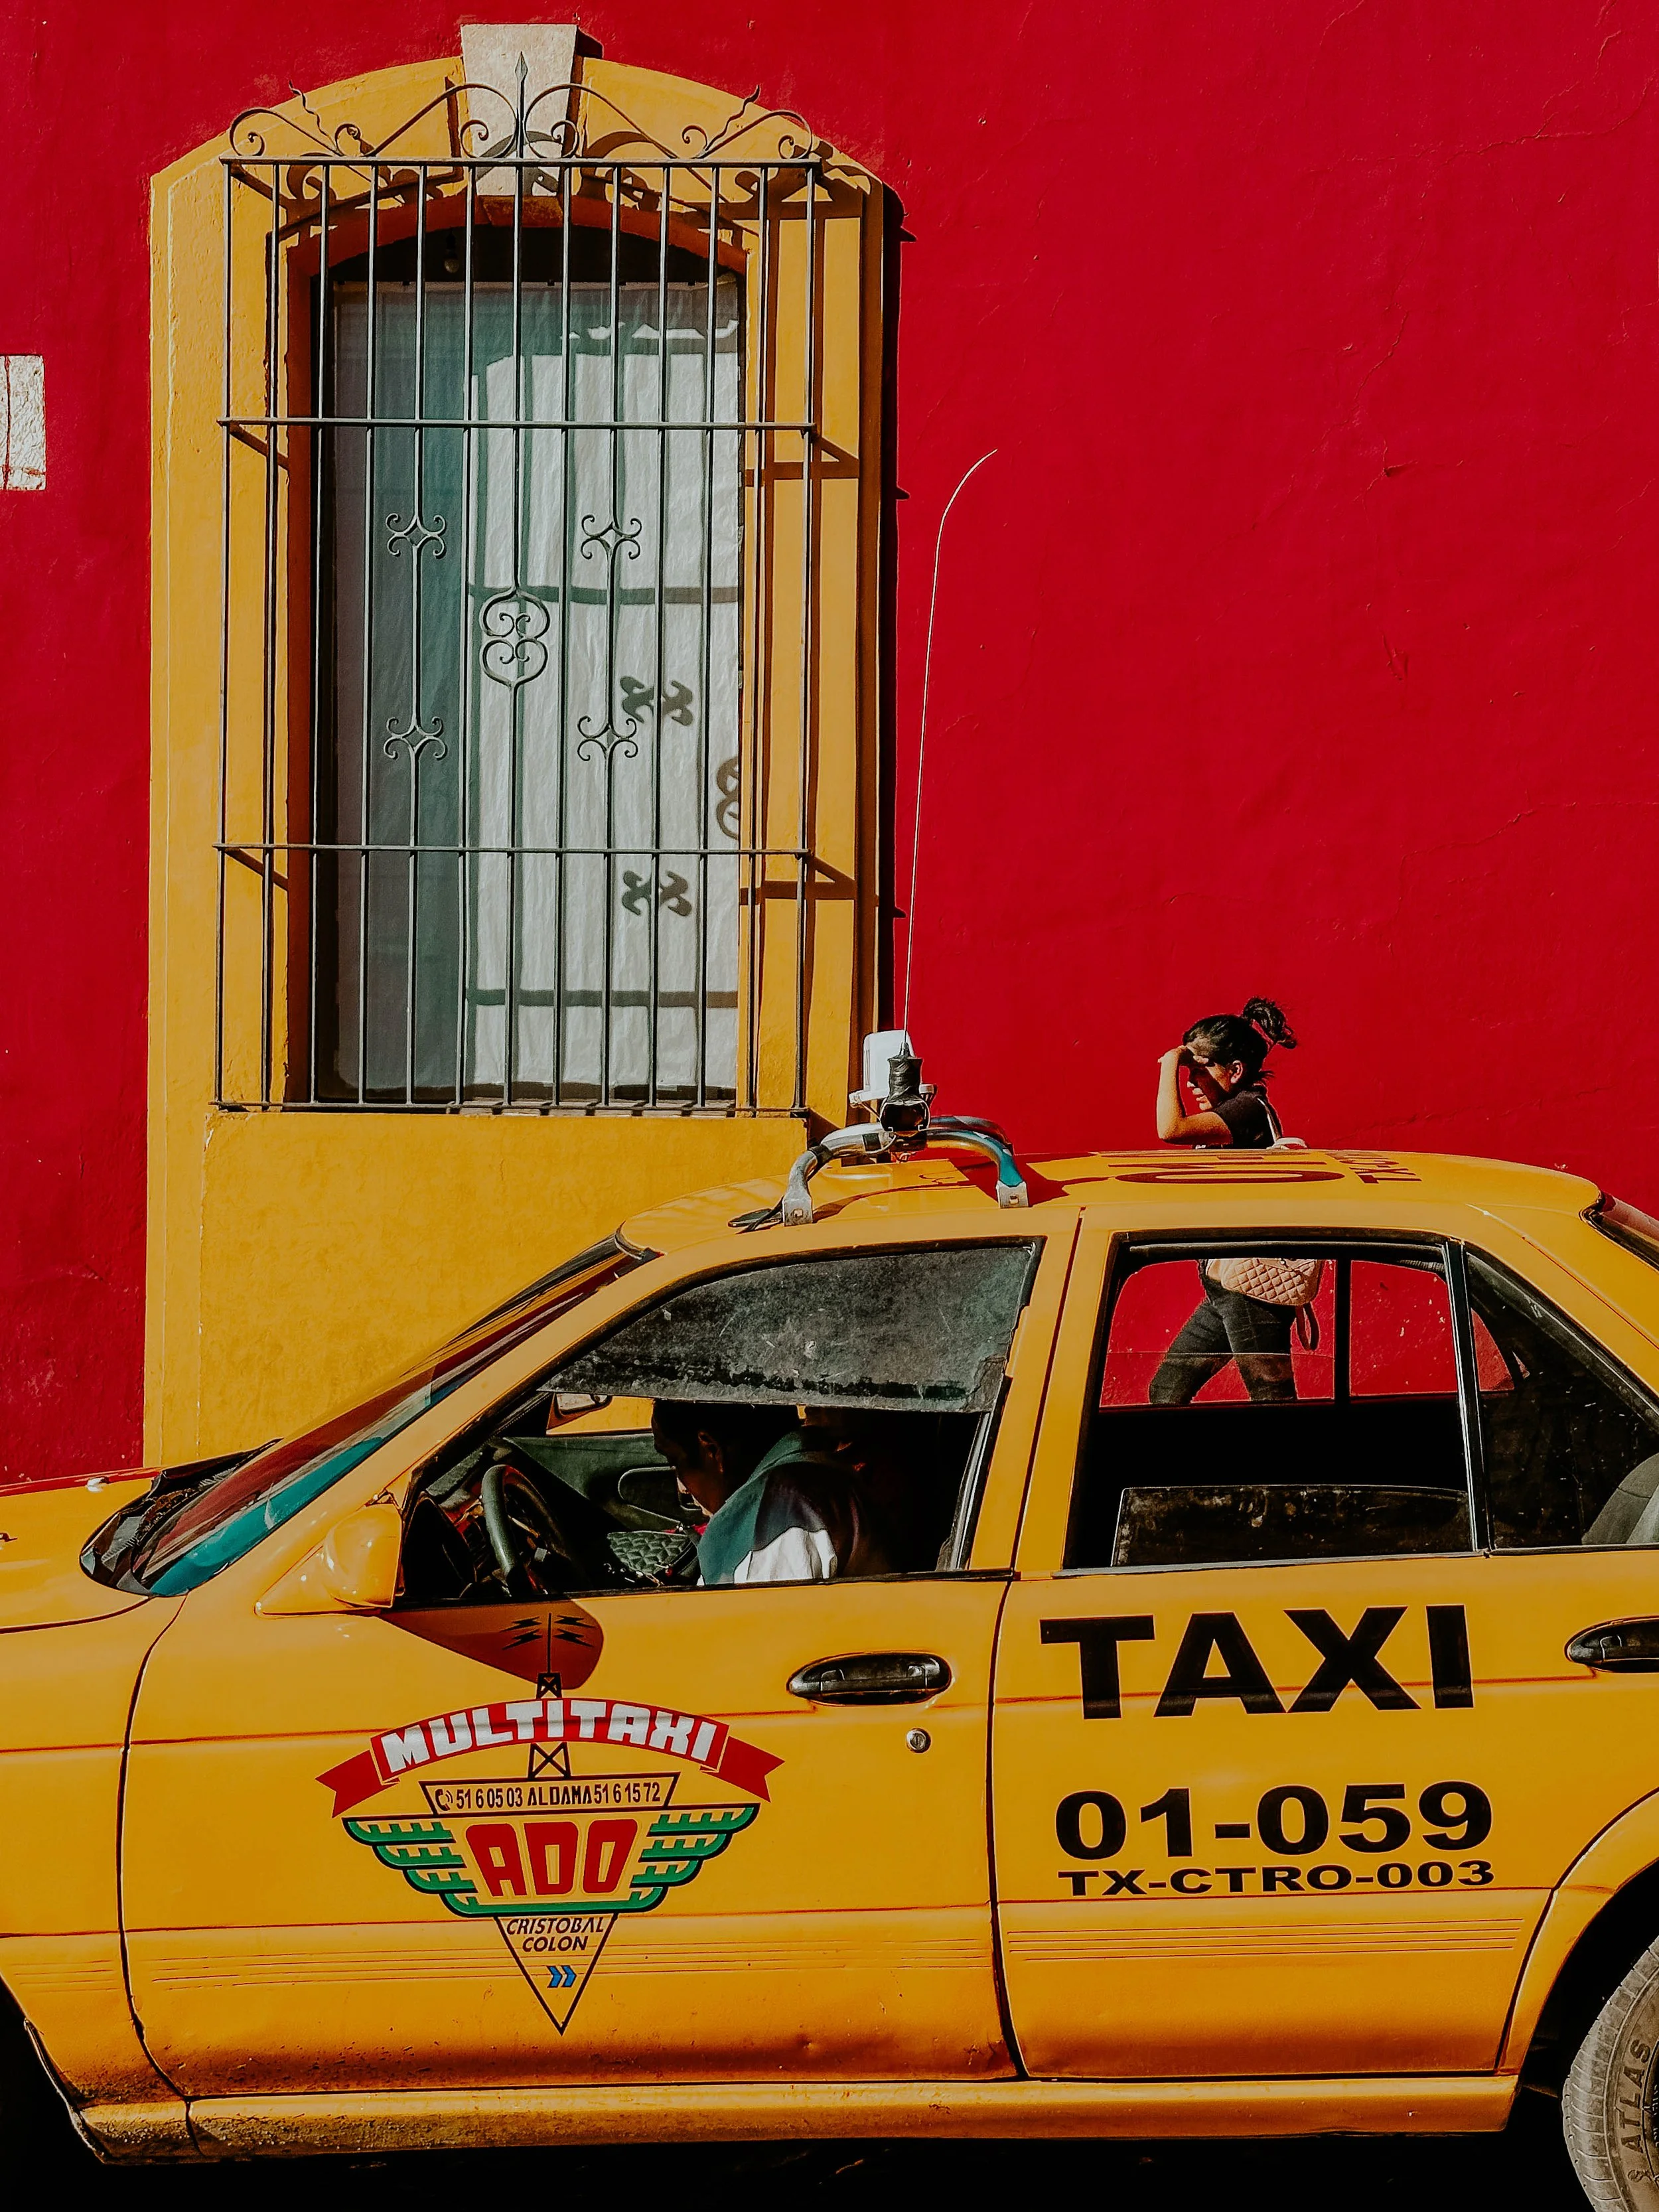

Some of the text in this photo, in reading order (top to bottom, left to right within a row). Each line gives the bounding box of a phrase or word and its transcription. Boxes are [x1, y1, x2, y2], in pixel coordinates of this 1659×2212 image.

[1040, 1604, 1475, 1719] TAXI
[382, 1700, 717, 1773] MULTITAXI
[456, 1788, 472, 1809] 51
[475, 1788, 484, 1808] 6
[487, 1787, 503, 1808] 05
[507, 1787, 523, 1808] 03
[528, 1785, 592, 1806] ALDAMA
[1055, 1781, 1492, 1860] 01-059
[465, 1818, 638, 1897] ADO
[1058, 1860, 1494, 1896] TX-CTRO-003
[506, 1917, 605, 1935] CRISTOBAL
[522, 1936, 588, 1953] COLON
[1620, 2039, 1652, 2154] ATLAS
